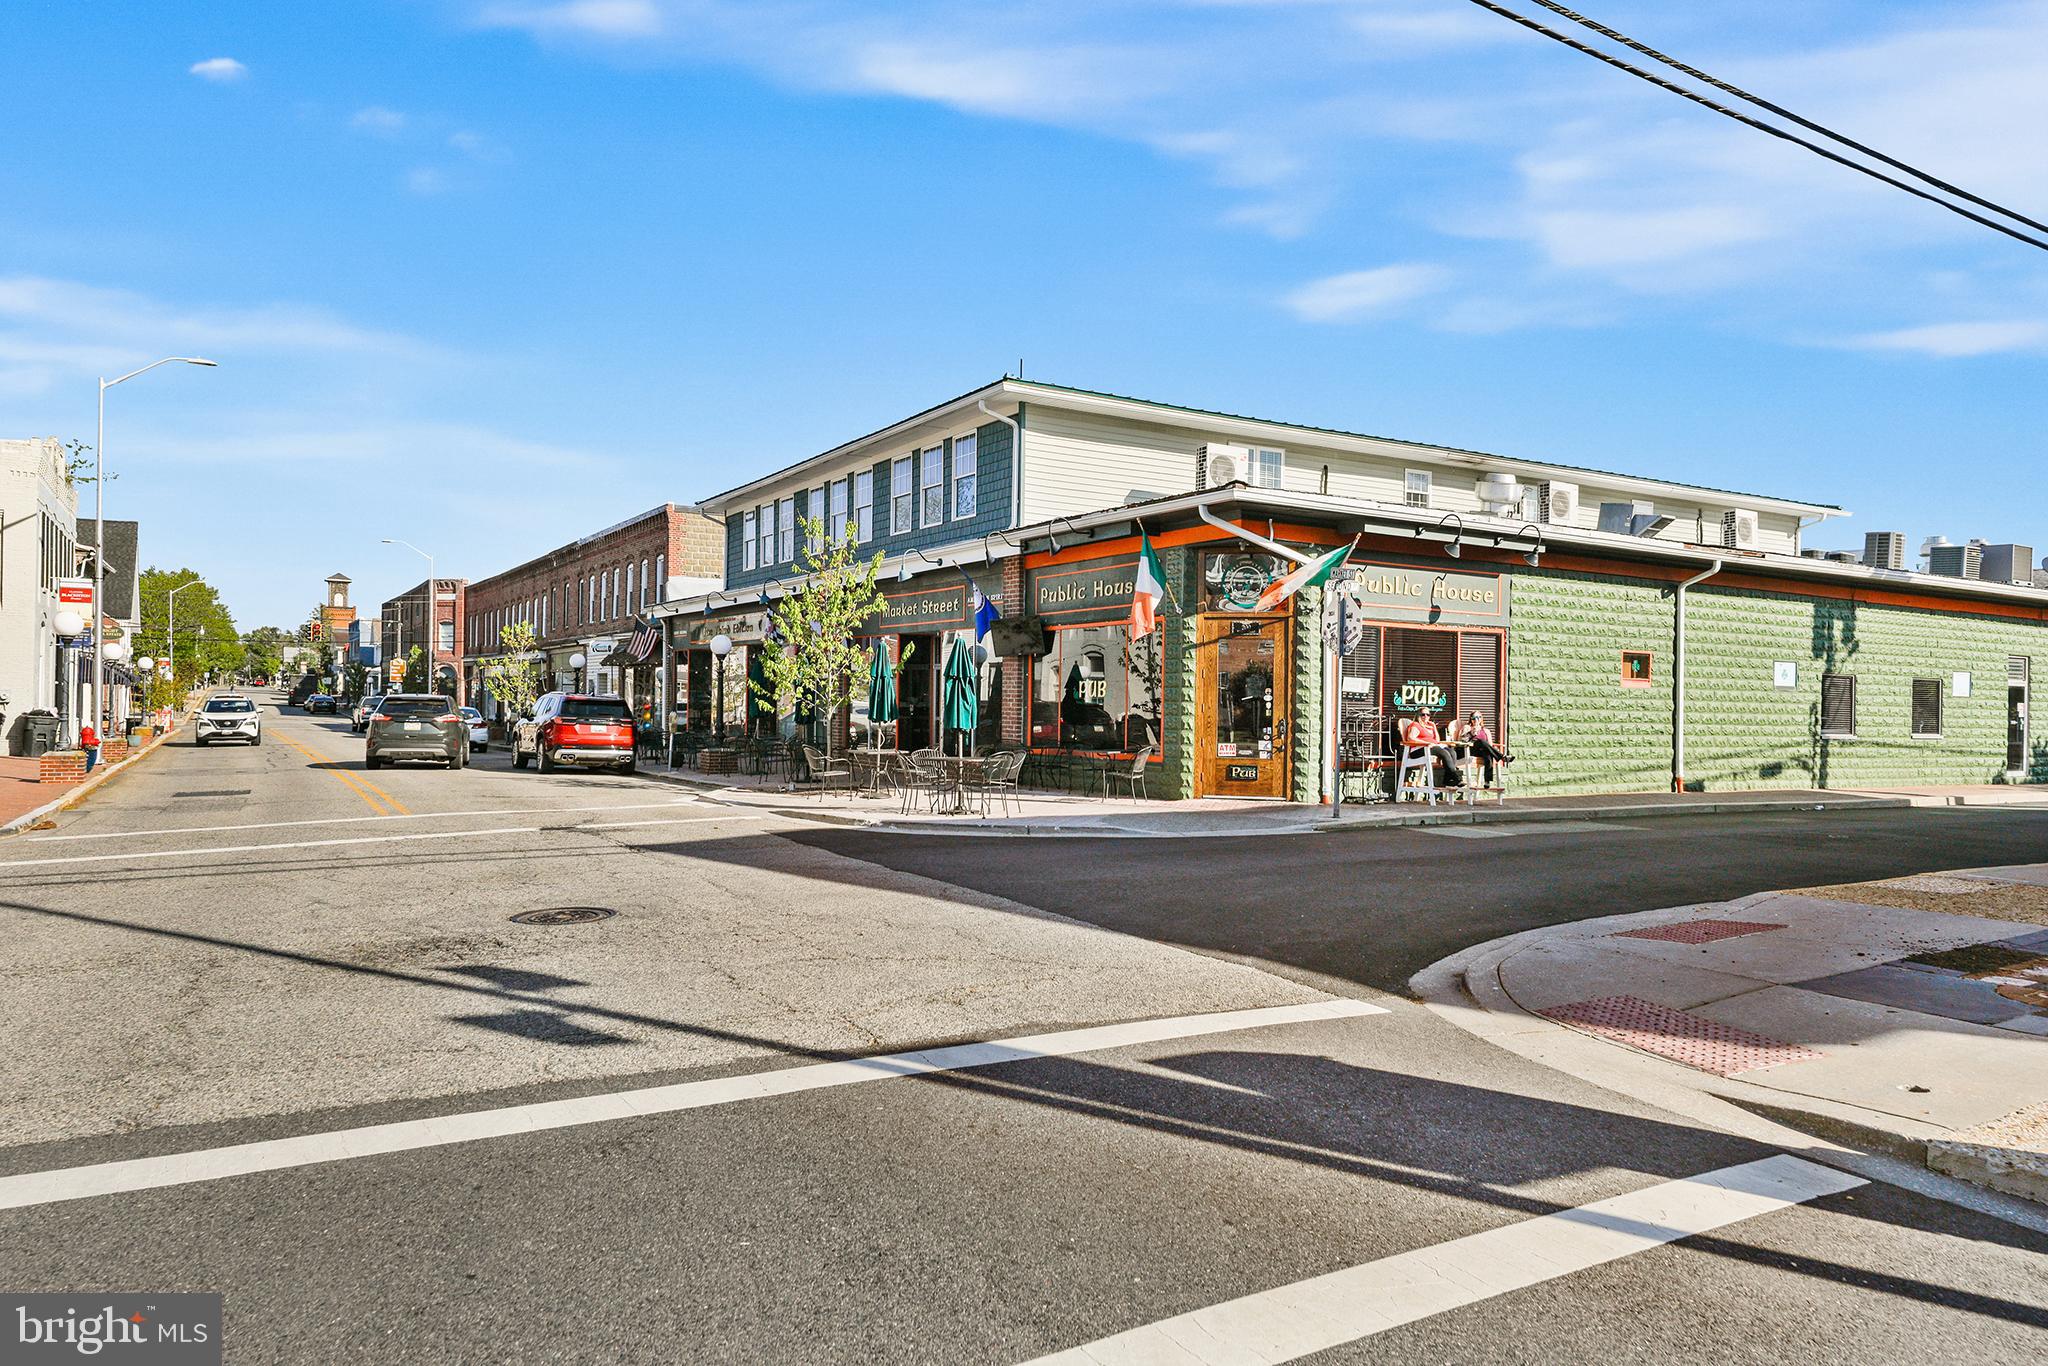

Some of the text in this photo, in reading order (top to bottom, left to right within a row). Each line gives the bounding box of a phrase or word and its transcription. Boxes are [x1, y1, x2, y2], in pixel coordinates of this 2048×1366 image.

[1040, 580, 1133, 603] Public Hous
[1354, 570, 1494, 603] Public House
[883, 598, 959, 618] Market Street
[1079, 679, 1107, 698] PUB
[1402, 685, 1440, 705] PUB
[1220, 744, 1236, 752] ATM
